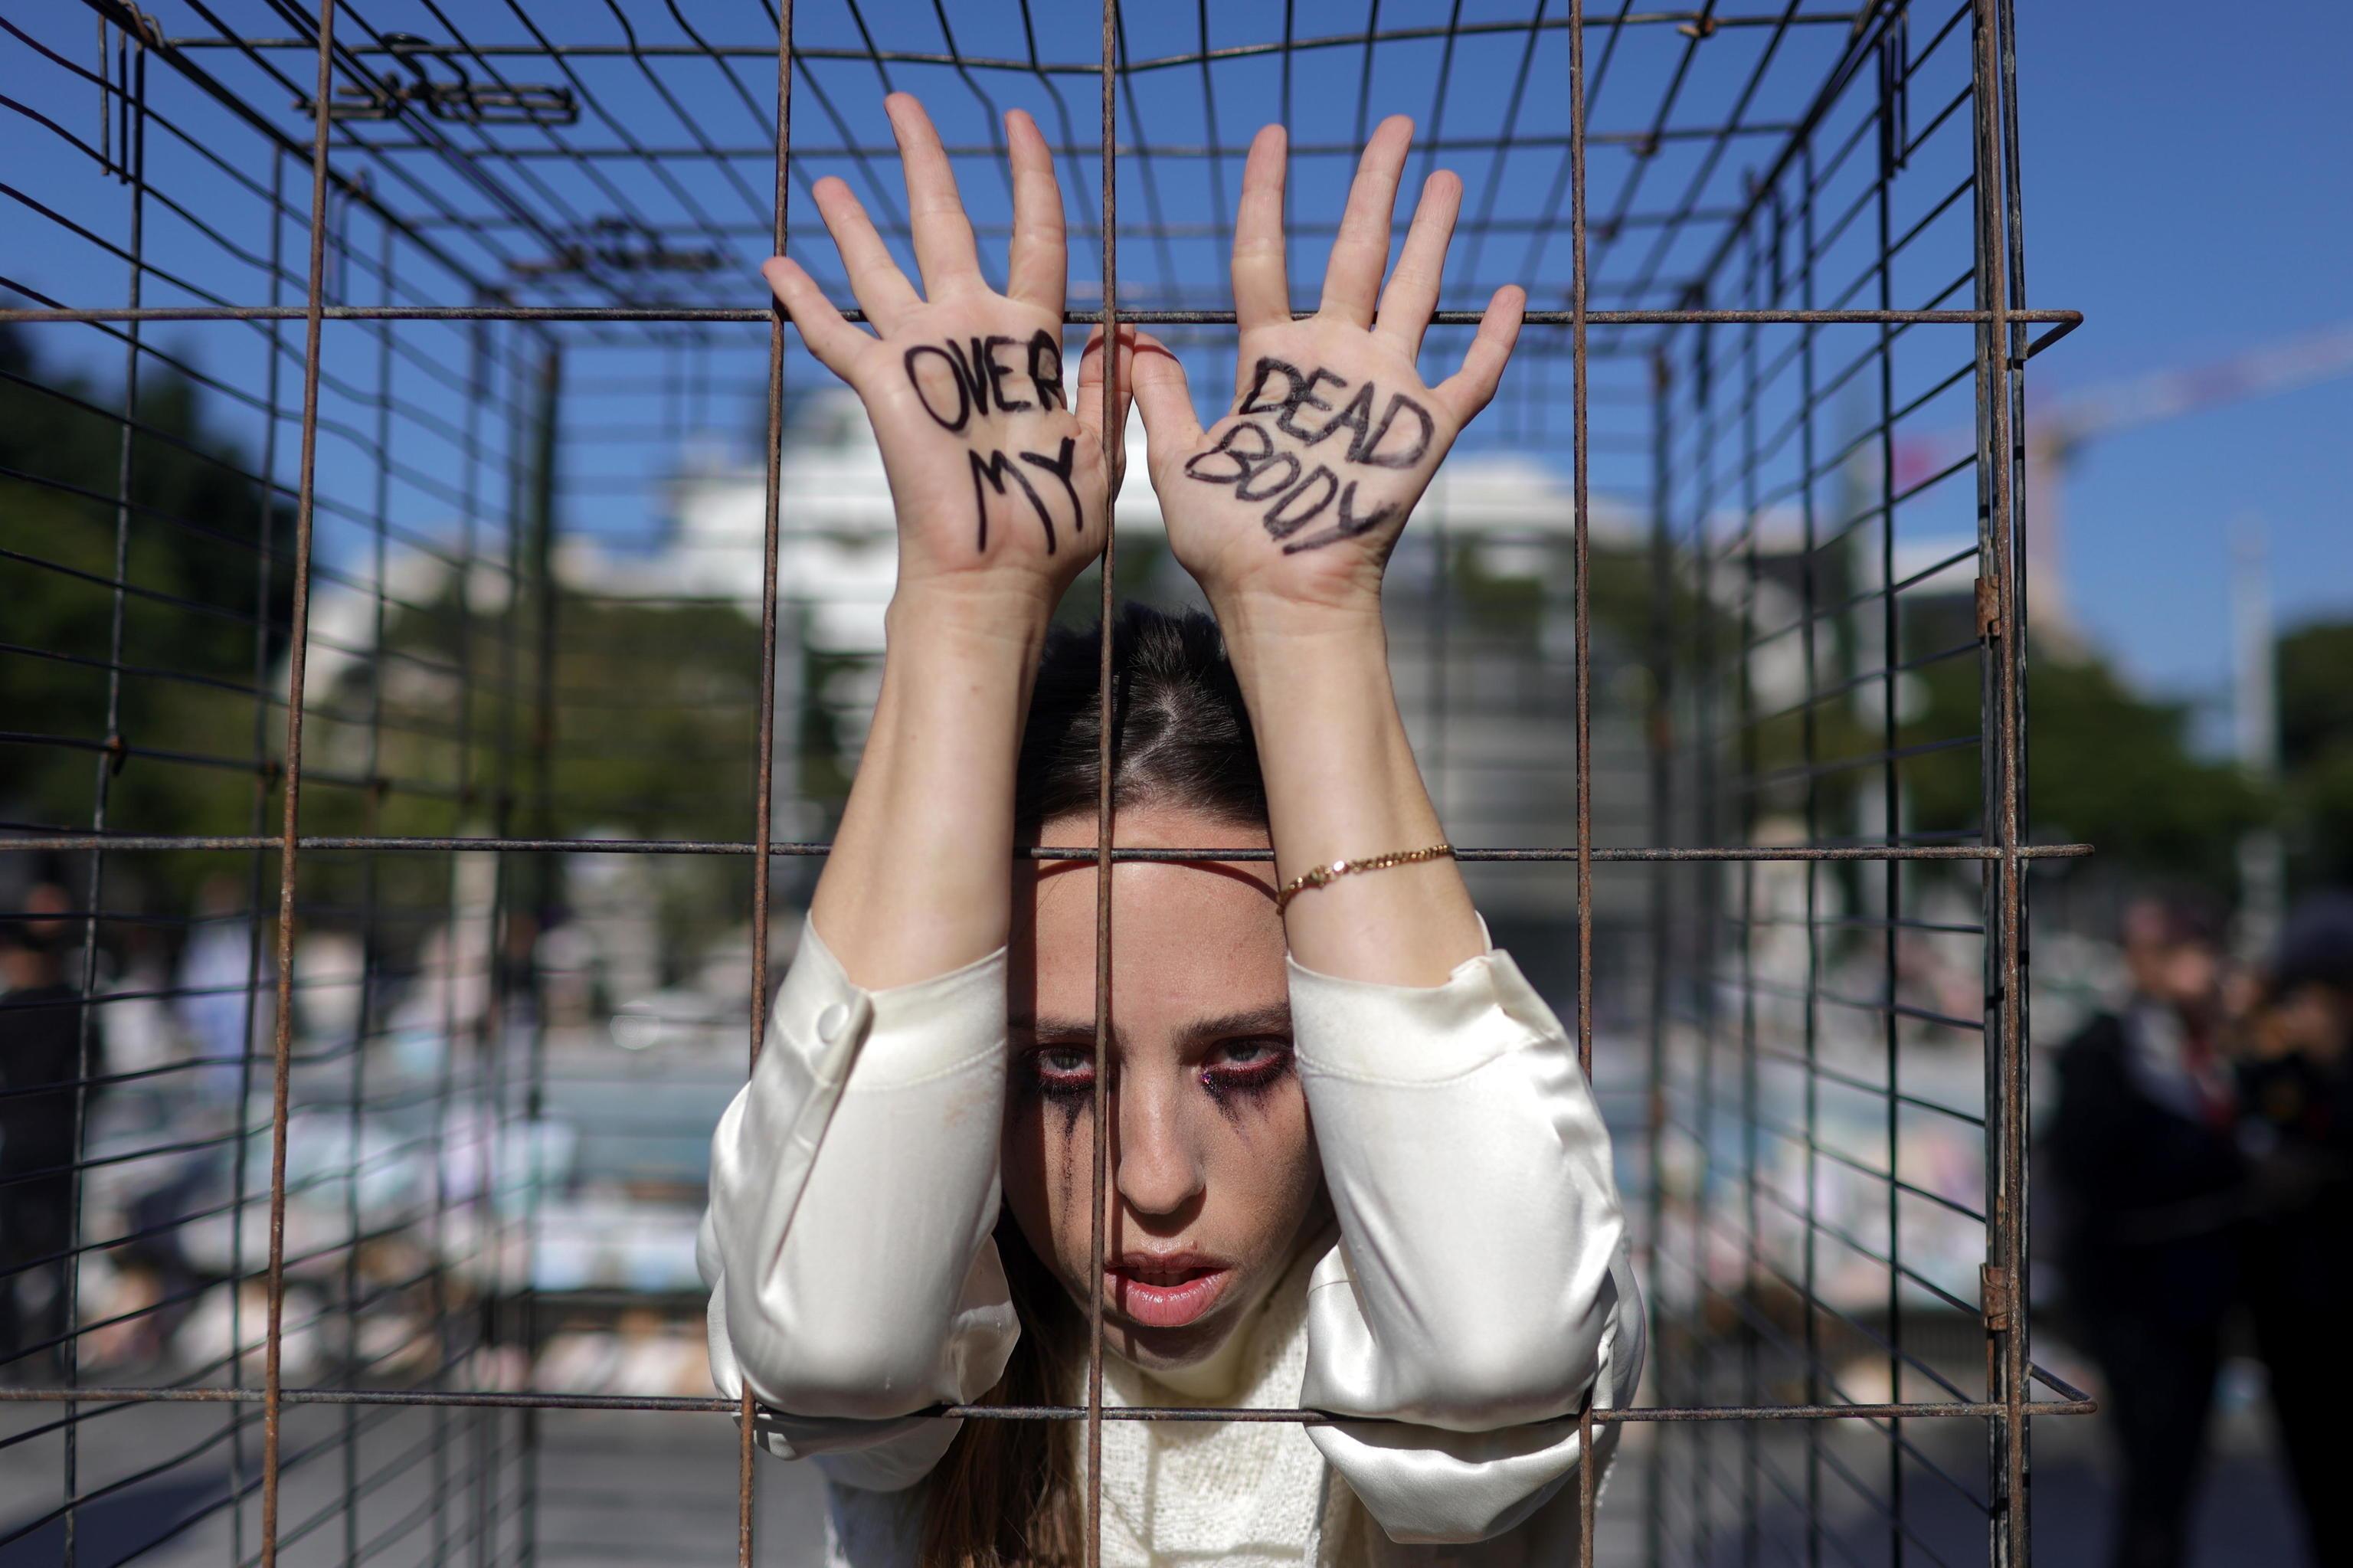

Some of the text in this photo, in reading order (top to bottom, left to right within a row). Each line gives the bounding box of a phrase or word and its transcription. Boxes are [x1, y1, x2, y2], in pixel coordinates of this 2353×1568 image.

[905, 329, 1068, 431] OVER
[1239, 355, 1435, 469] DEAD
[969, 437, 1083, 555] MY
[1184, 421, 1401, 555] BODY
